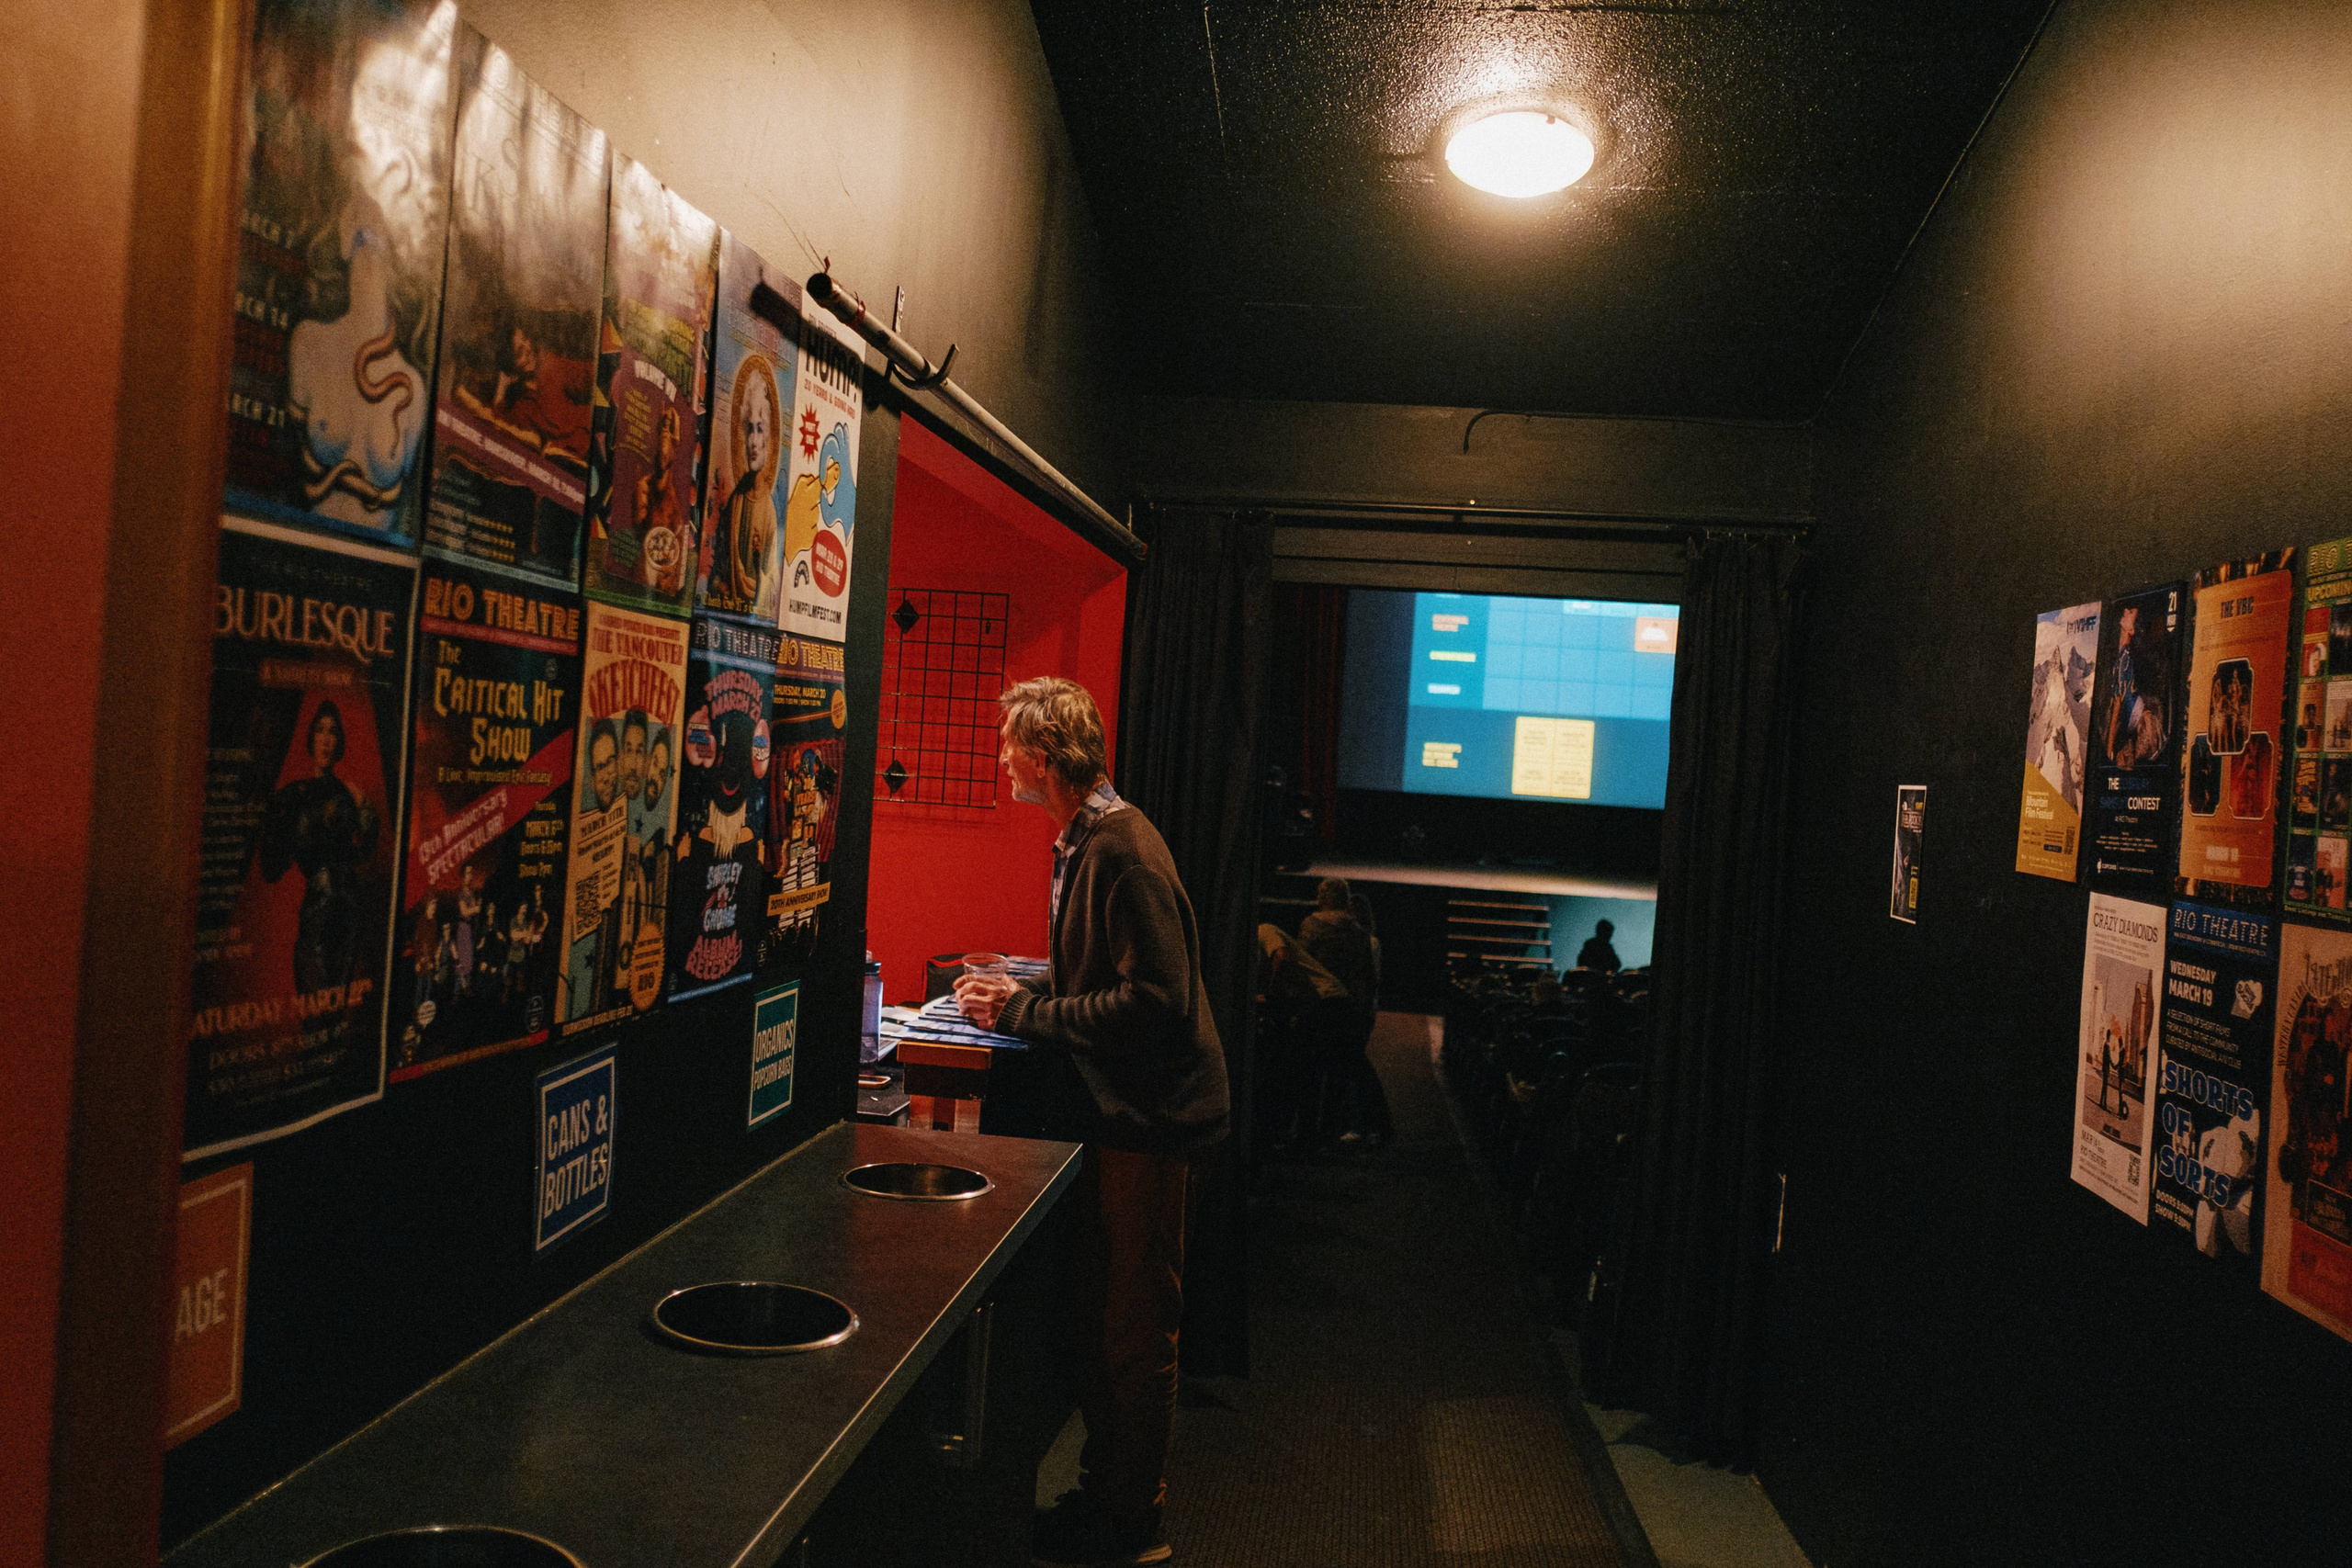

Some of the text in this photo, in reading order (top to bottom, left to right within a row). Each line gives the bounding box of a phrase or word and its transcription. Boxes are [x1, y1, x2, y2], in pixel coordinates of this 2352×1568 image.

[424, 576, 475, 623] RIO
[481, 588, 581, 643] THEATRE
[2169, 591, 2178, 614] 21
[215, 583, 396, 667] BURLESQUE
[694, 620, 721, 651] RIO
[723, 628, 780, 663] THEATRE
[593, 626, 614, 654] THE
[616, 631, 684, 666] VANCOUVER
[800, 640, 844, 672] THEATRE
[434, 667, 564, 727] CRITICAL HIT
[703, 670, 763, 703] THURSDAY
[711, 691, 750, 720] MARCH
[469, 717, 531, 766] SHOW
[2108, 777, 2120, 791] THE
[2127, 796, 2162, 810] CONTEST
[786, 891, 816, 908] ANNIVERSARY
[694, 930, 738, 960] ALBUM
[2093, 912, 2158, 943] CRAZY DIAMONDS
[2174, 908, 2197, 932] RIO
[2201, 913, 2269, 947] THEATRE
[684, 939, 743, 980] RELEASE
[2169, 960, 2218, 985] WEDNESDAY
[2168, 977, 2213, 1008] MARCH 19
[191, 998, 281, 1039] ATURDAY
[753, 1018, 795, 1063] ORGANICS
[752, 1055, 792, 1091] POPCORN BAGS
[2164, 1060, 2255, 1122] SHORTS
[547, 1094, 609, 1162] CANS &
[2161, 1100, 2192, 1139] OF
[543, 1141, 609, 1220] BOTTLES
[2158, 1143, 2232, 1208] SORTS
